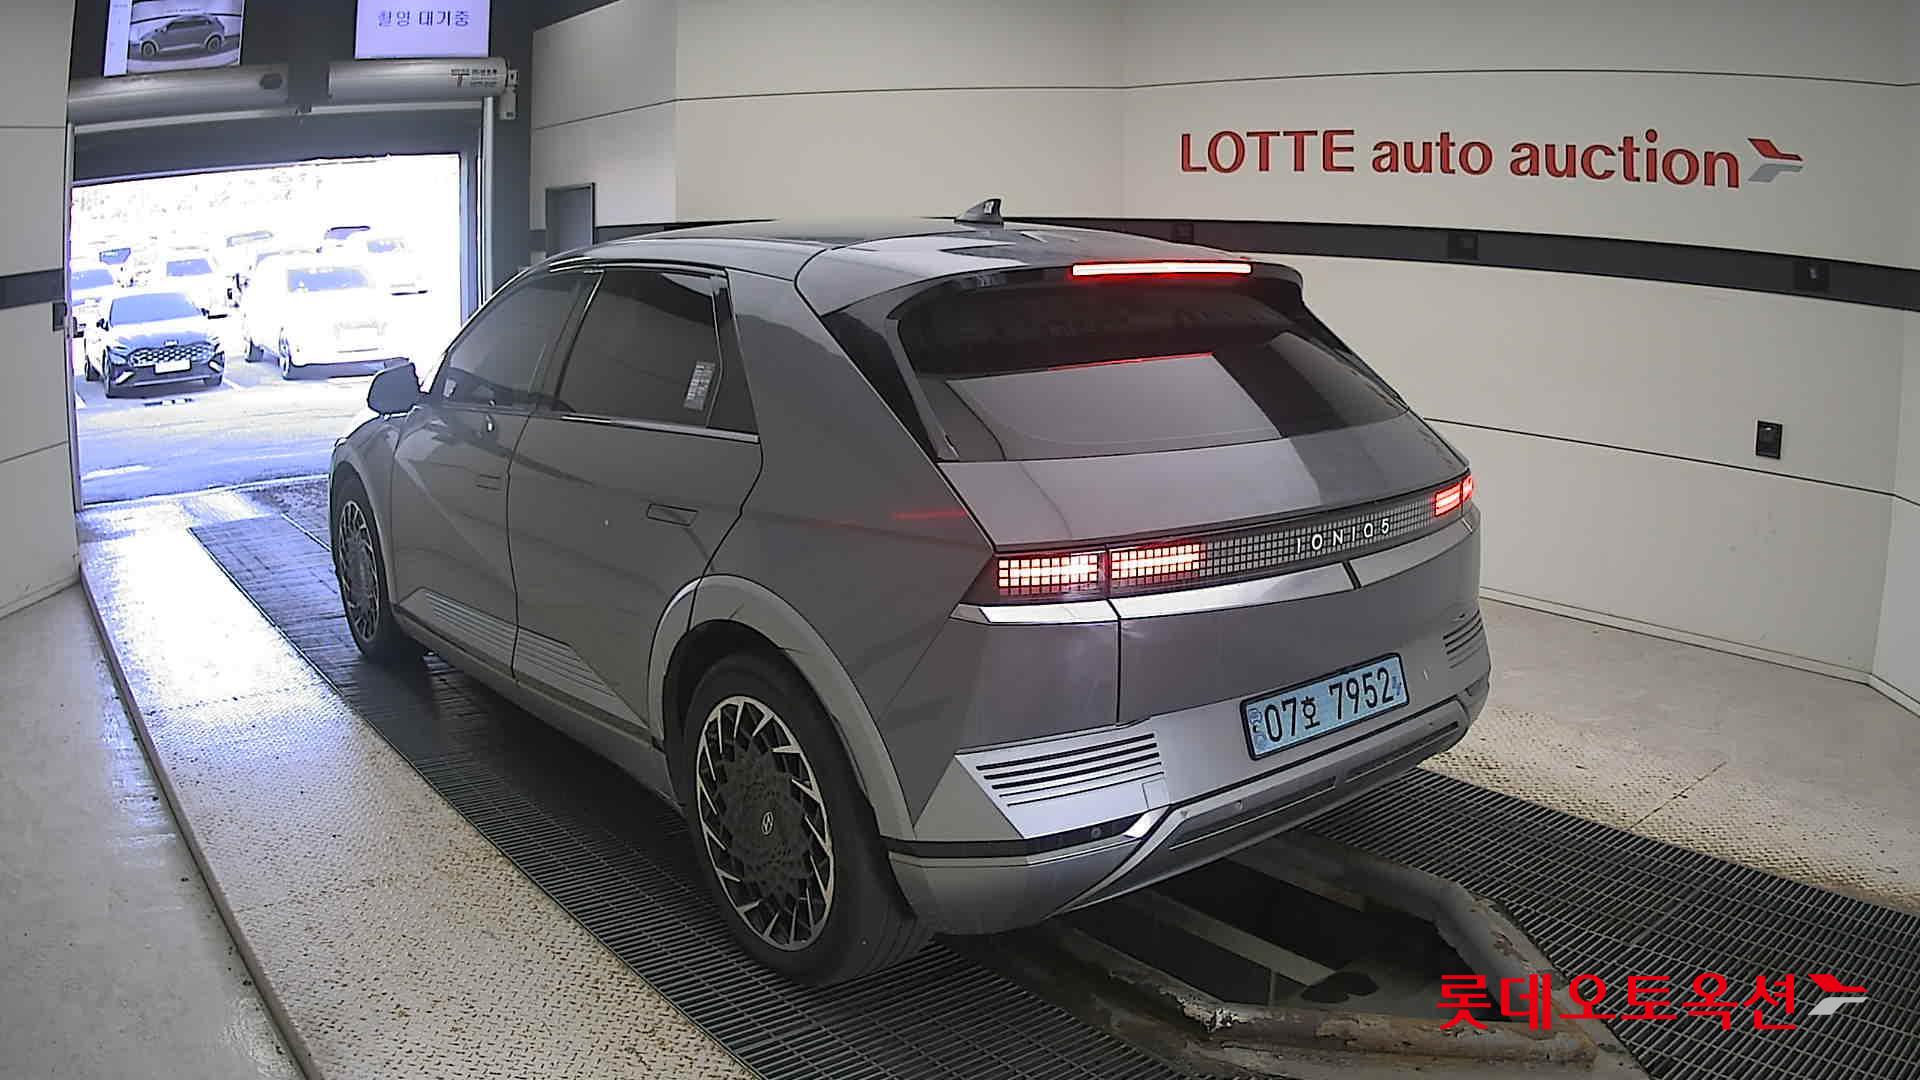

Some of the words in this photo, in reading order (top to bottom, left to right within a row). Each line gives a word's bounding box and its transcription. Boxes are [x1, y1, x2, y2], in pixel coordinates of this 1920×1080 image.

[1180, 129, 1355, 173] LOTTE
[1371, 132, 1494, 176] auto
[1509, 129, 1740, 188] auction
[1264, 695, 1321, 742] 07호
[1328, 667, 1394, 720] 7952
